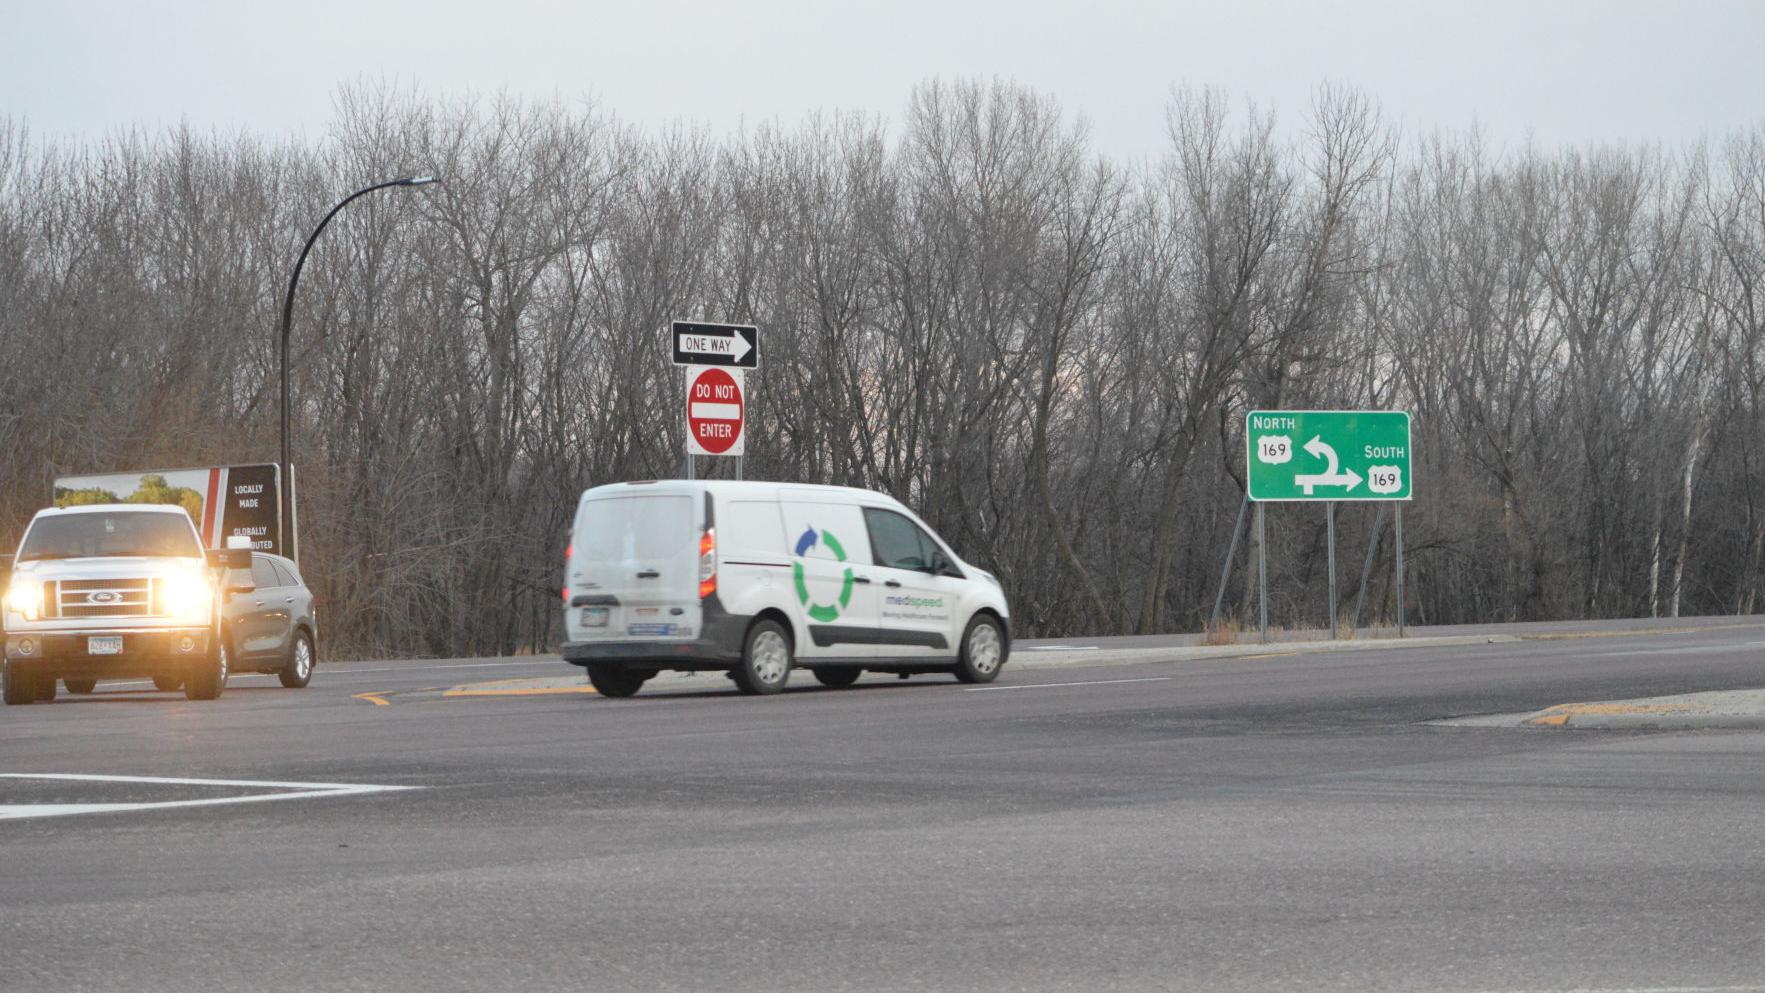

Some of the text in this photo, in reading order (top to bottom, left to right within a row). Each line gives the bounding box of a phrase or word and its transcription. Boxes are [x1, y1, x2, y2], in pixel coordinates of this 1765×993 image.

[686, 337, 732, 353] ONE WAY
[696, 384, 735, 399] DO NOT
[1253, 416, 1295, 430] NORTH
[700, 423, 732, 438] ENTER
[1263, 443, 1286, 457] 169
[1364, 445, 1405, 459] SOUTH
[1373, 473, 1397, 487] 169
[234, 484, 264, 494] LOCALLY
[239, 498, 259, 508] MADE
[233, 526, 267, 536] GLOBALLY
